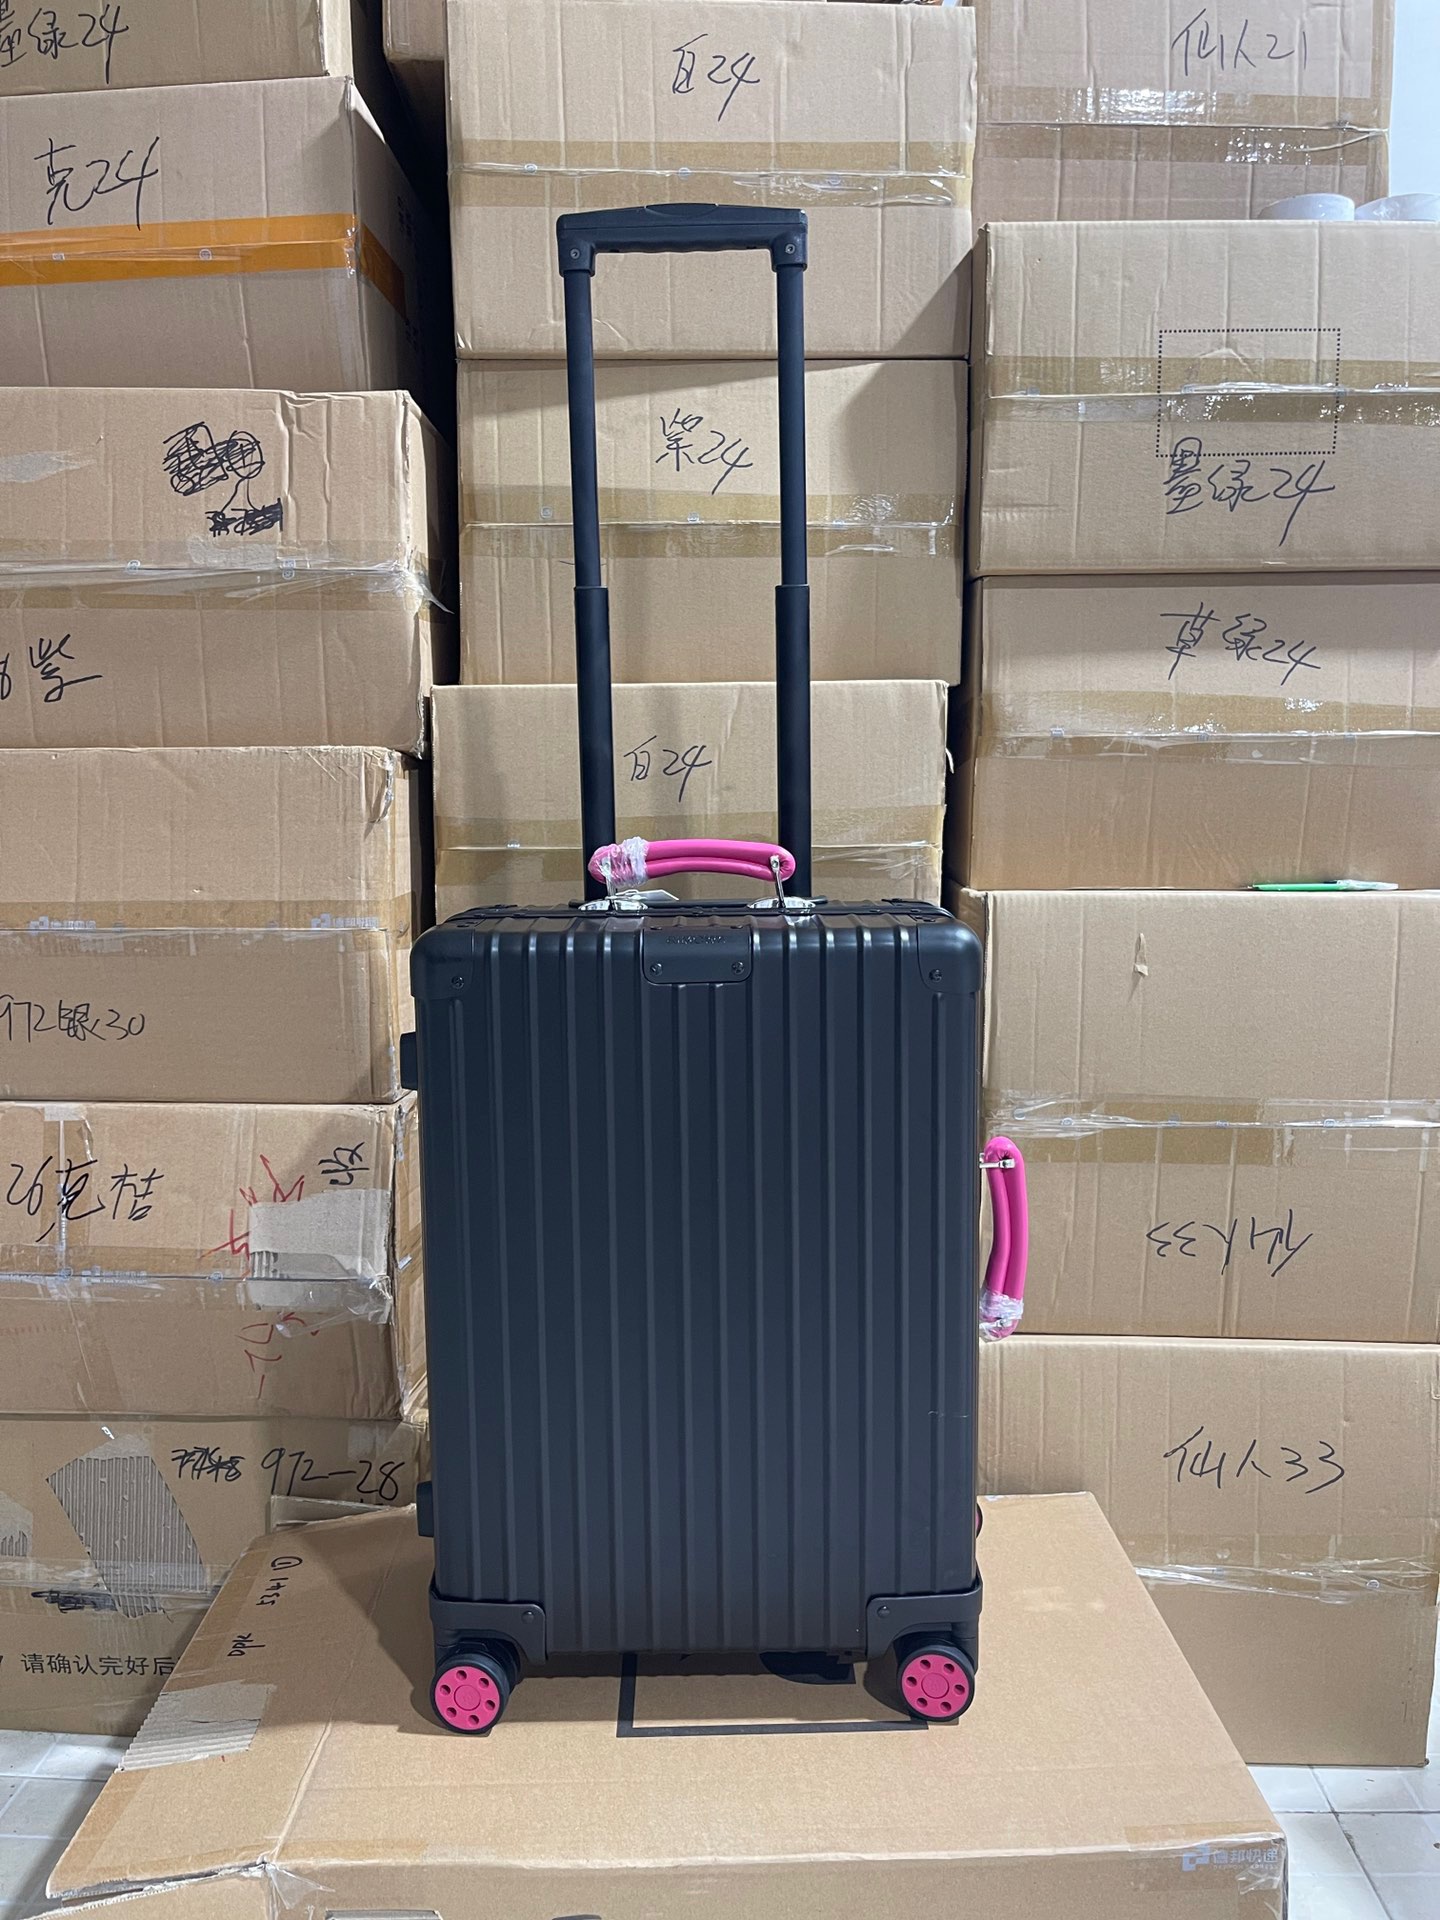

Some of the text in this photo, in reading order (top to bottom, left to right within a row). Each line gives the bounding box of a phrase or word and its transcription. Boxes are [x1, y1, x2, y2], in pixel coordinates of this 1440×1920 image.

[20, 1653, 180, 1676] 请确认完好后
